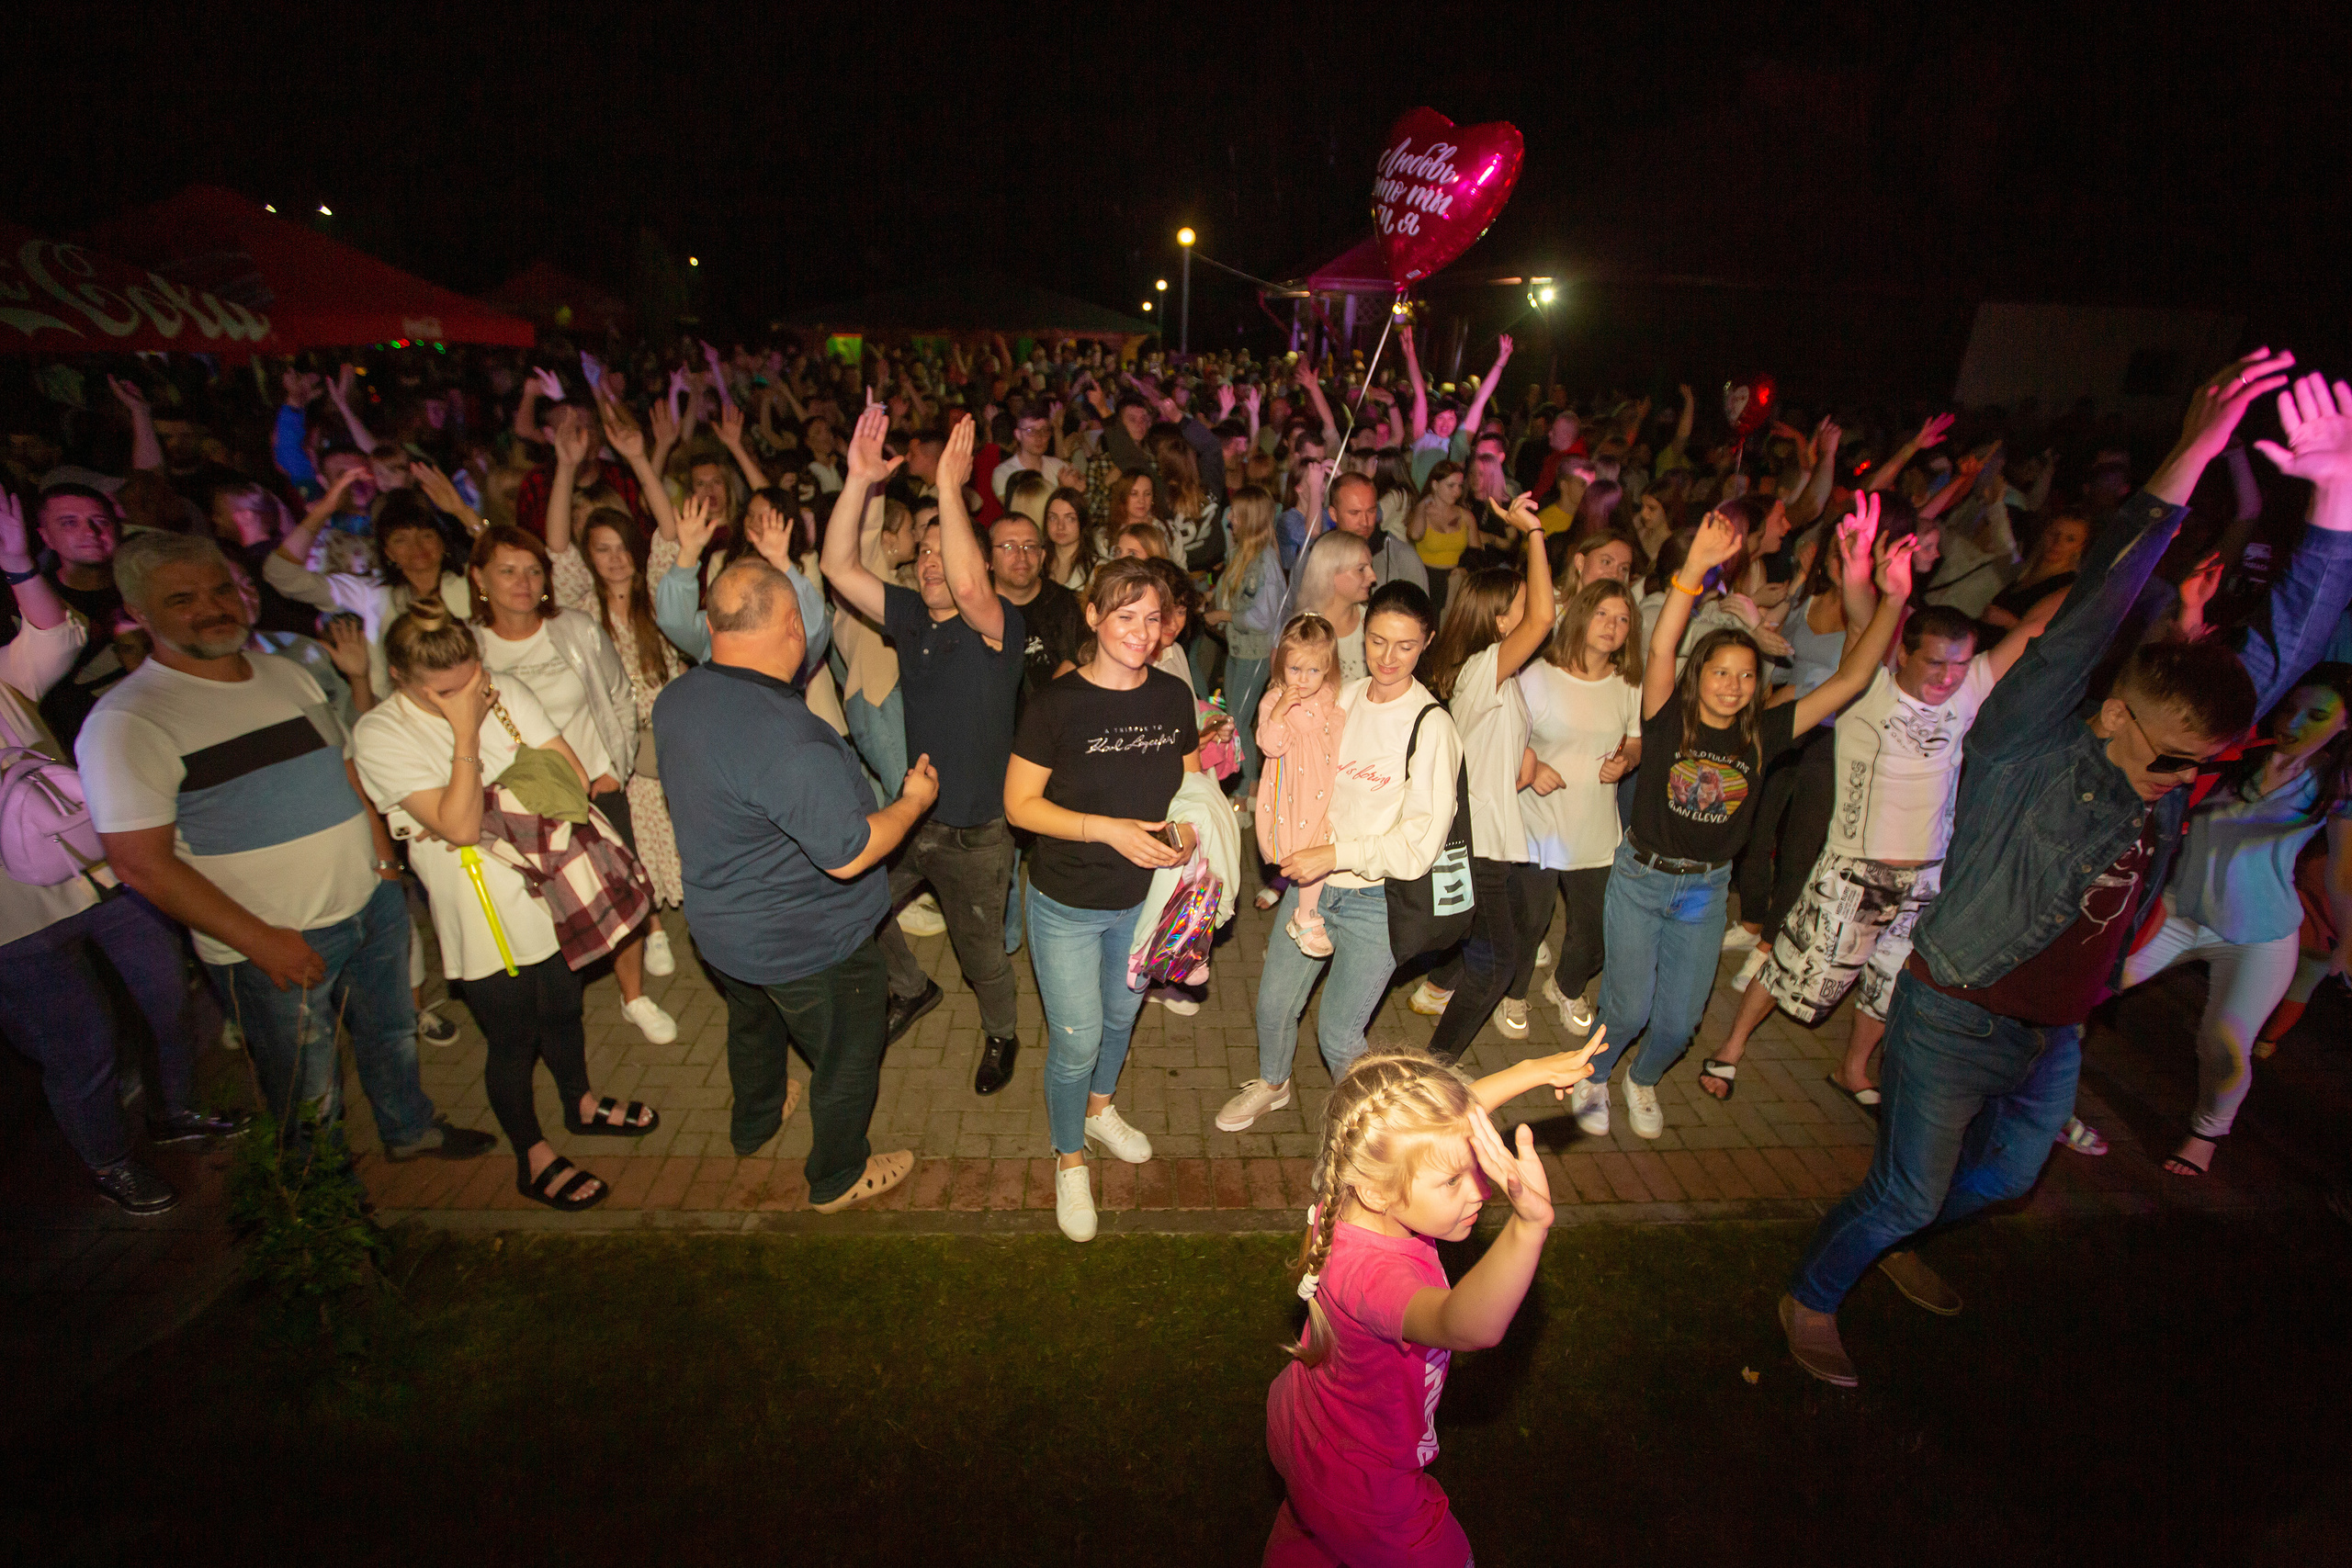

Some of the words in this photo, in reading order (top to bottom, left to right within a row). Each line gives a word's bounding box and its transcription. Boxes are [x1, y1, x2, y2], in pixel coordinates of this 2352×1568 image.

[1351, 764, 1392, 792] boring
[1842, 761, 1867, 840] adidas
[1691, 811, 1730, 824] ELEVEN
